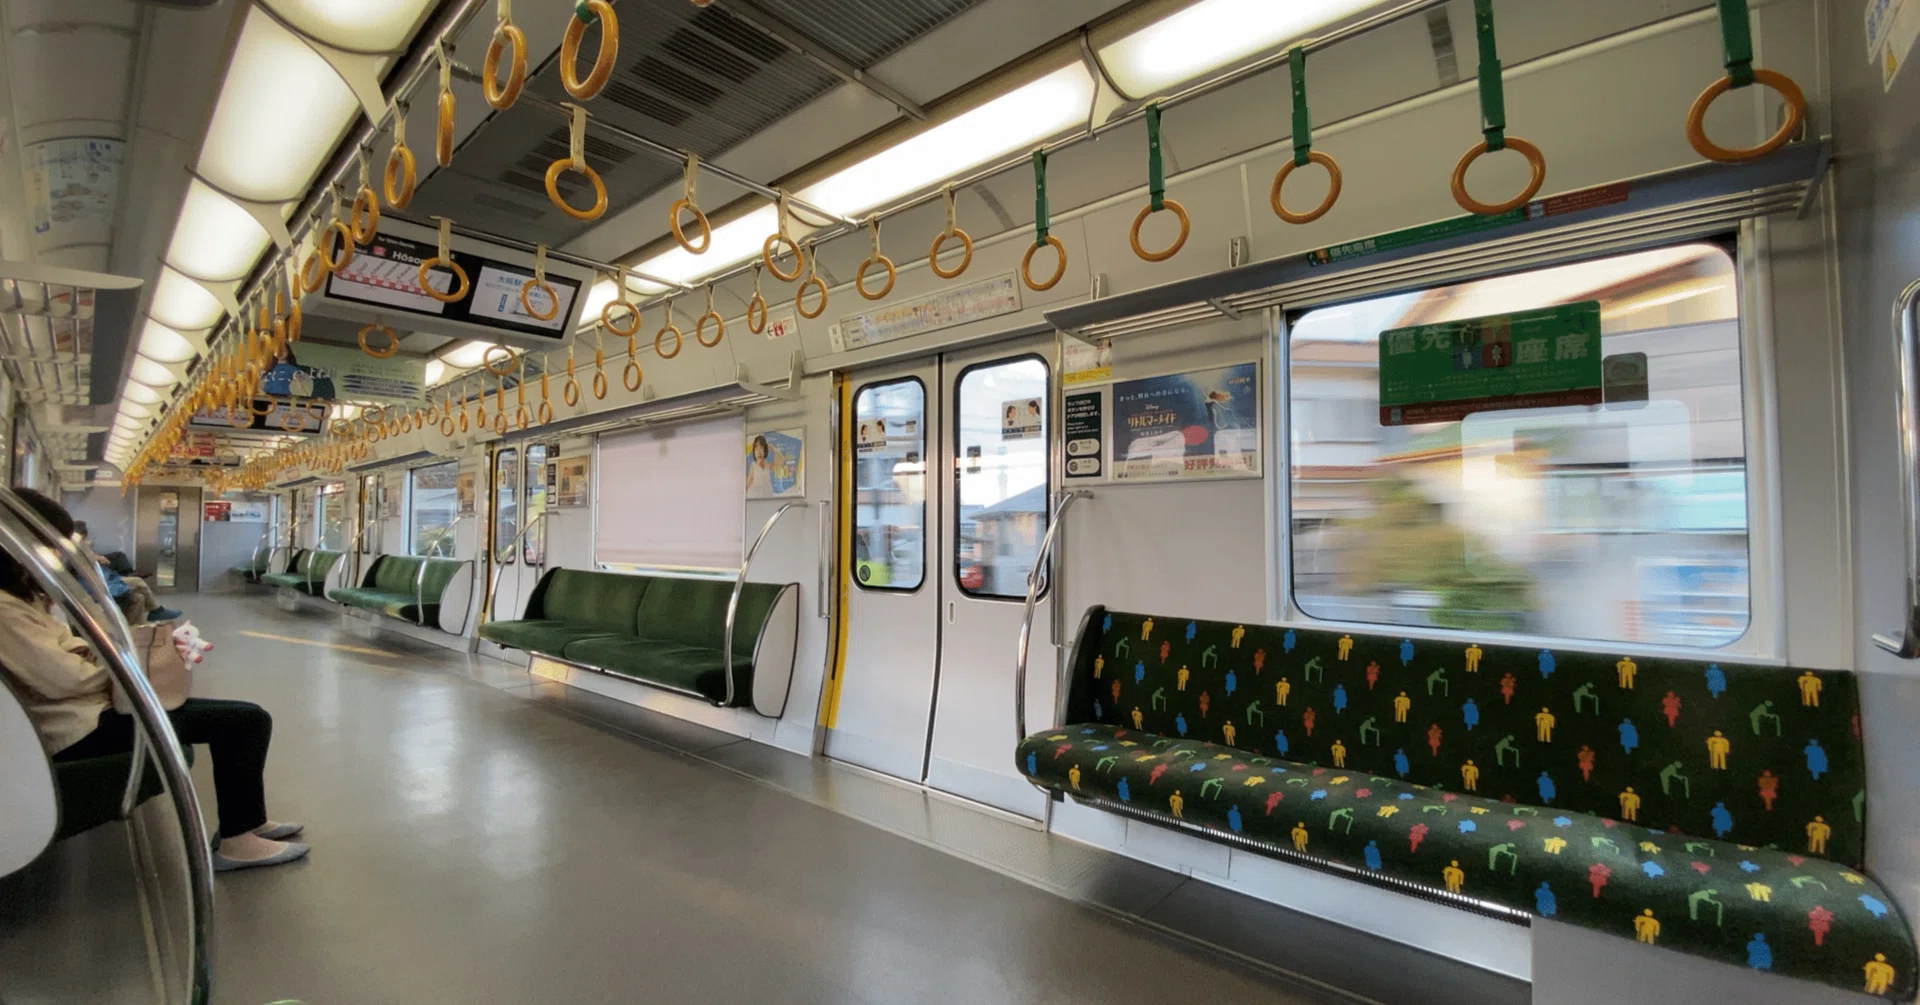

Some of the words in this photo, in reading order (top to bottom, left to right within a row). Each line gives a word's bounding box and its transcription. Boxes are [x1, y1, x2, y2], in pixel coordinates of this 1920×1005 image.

[392, 250, 423, 265] Hōso
[1515, 333, 1591, 364] 座席
[1127, 412, 1177, 428] リトルマーメイド
